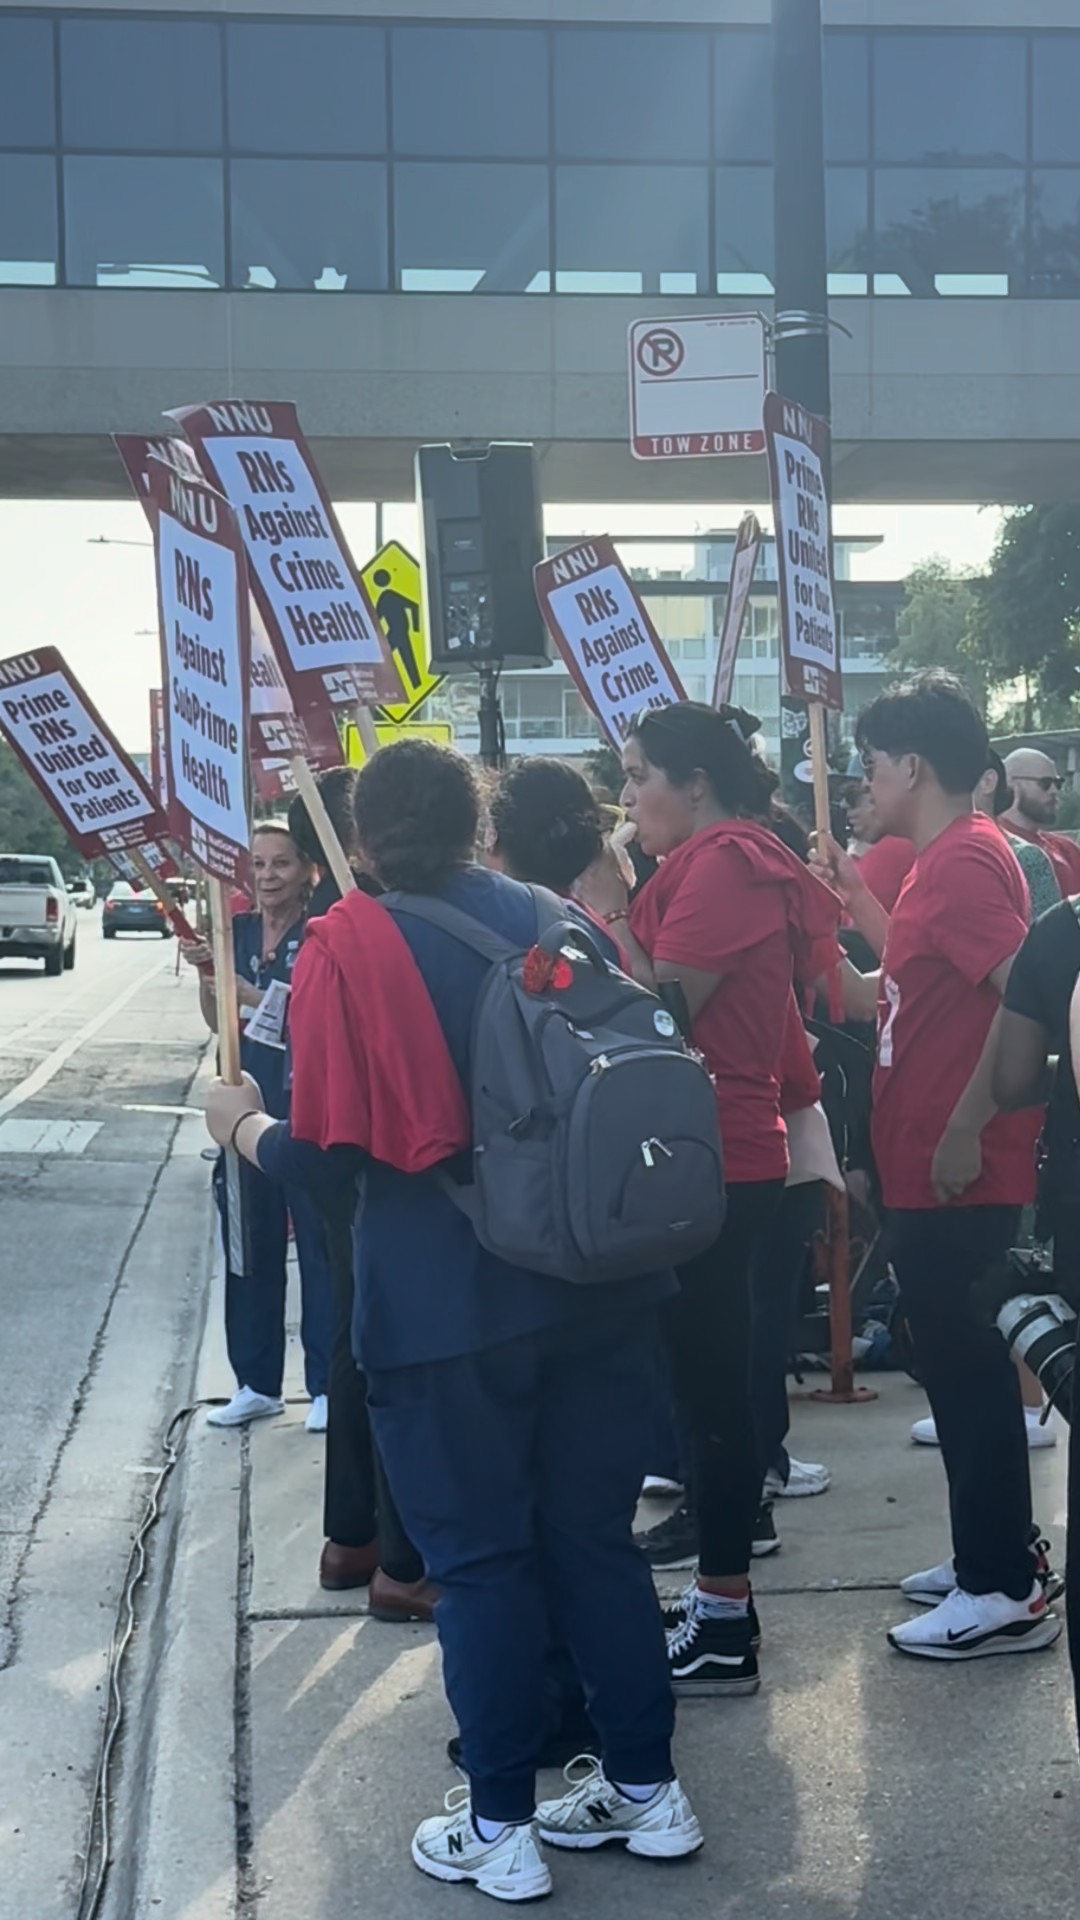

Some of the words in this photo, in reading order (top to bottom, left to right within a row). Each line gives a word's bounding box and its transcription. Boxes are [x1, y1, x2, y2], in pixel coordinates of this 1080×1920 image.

[206, 405, 273, 433] NNU
[651, 437, 690, 454] TOW
[700, 433, 752, 452] ZONE
[236, 451, 295, 493] RNs
[784, 450, 823, 500] Prime
[170, 475, 217, 533] NNU
[243, 502, 329, 546] Against
[796, 493, 819, 536] RNs
[270, 551, 345, 592] Crime
[552, 545, 599, 584] NNU
[788, 529, 828, 579] United
[175, 548, 213, 622] RNs
[575, 585, 620, 626] RNs
[794, 574, 813, 607] for
[814, 583, 830, 615] Our
[285, 601, 370, 646] Health
[580, 617, 645, 667] Against
[795, 611, 833, 655] Patients
[175, 619, 227, 687] Against
[601, 661, 659, 703] Crime
[2, 689, 70, 724] Prime
[174, 676, 238, 754] SubPrime
[29, 717, 78, 746] RNs
[34, 734, 109, 774] United
[181, 739, 231, 811] Health
[57, 776, 84, 798] for
[84, 767, 121, 791] Our
[70, 788, 141, 822] Patients
